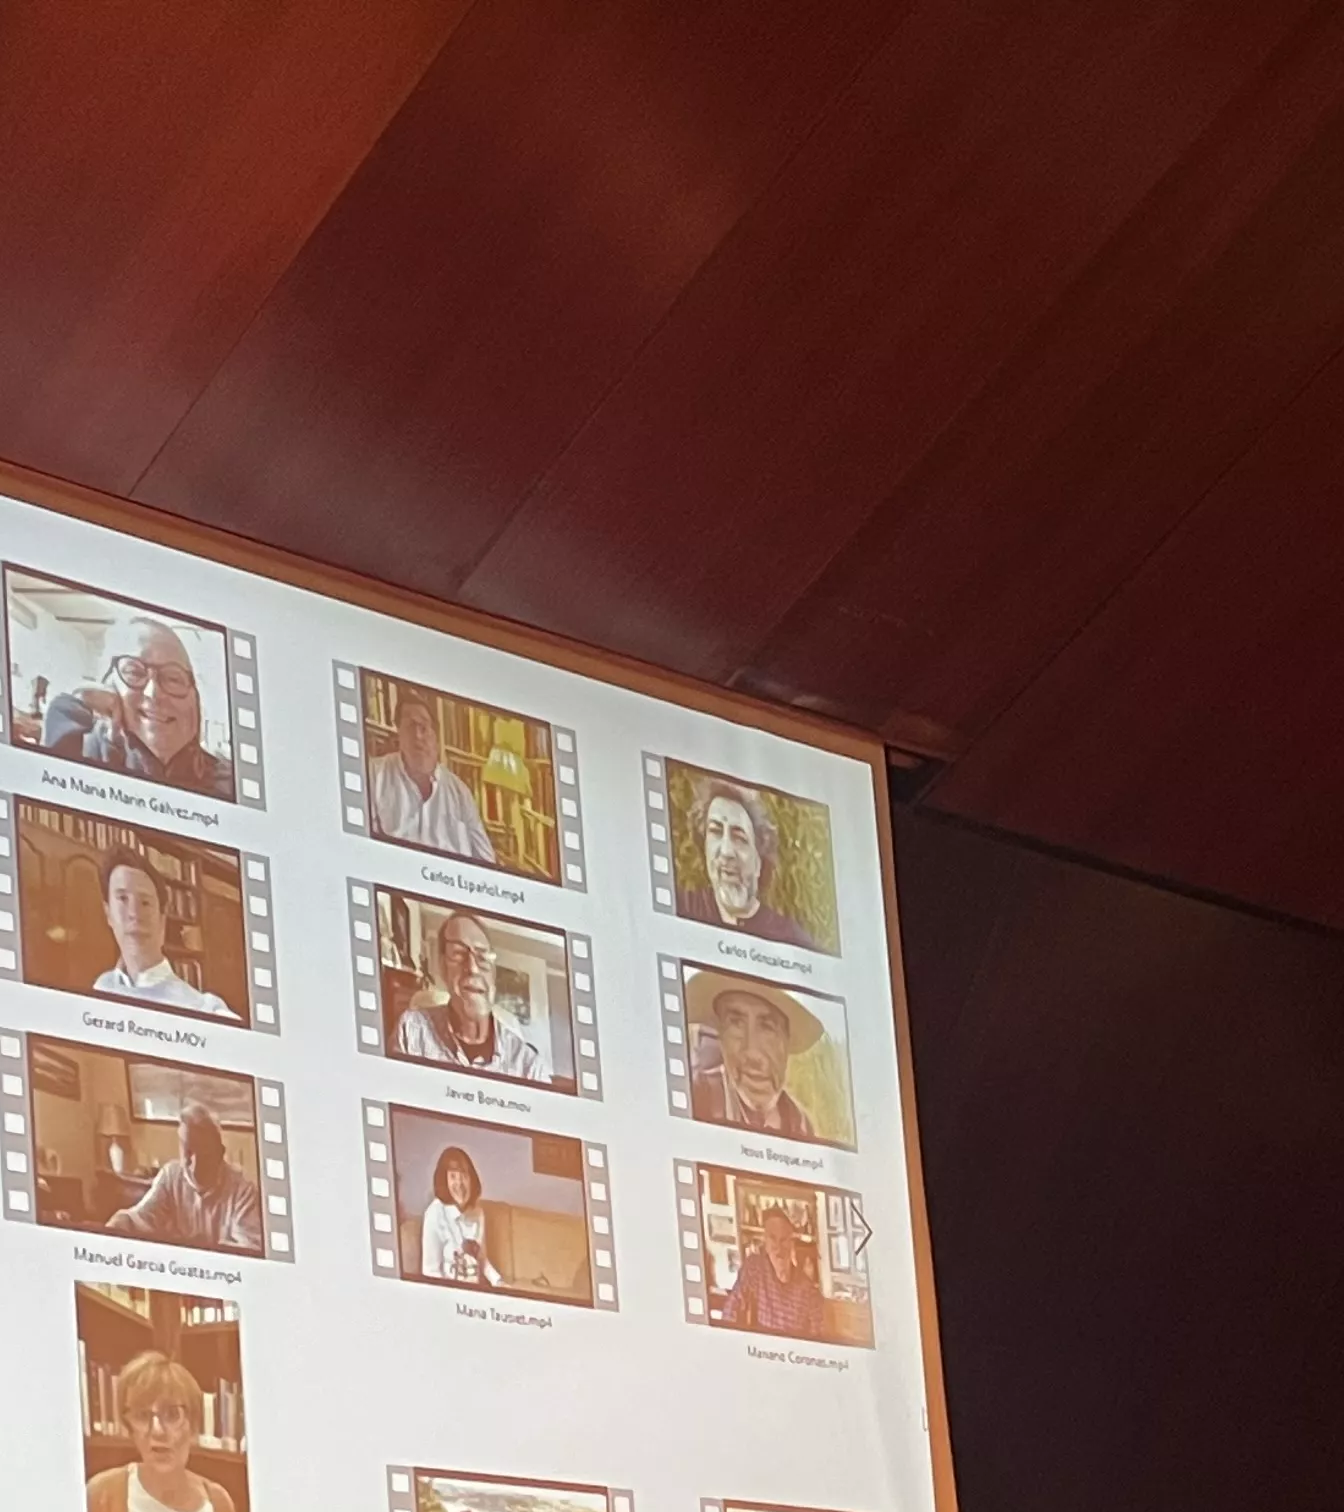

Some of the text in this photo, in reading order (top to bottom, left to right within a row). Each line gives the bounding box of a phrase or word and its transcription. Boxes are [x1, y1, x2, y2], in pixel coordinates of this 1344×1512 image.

[41, 769, 67, 789] Ana
[421, 866, 455, 886] Carlos
[82, 1011, 125, 1033] Gerard
[74, 1246, 123, 1267] Manuel
